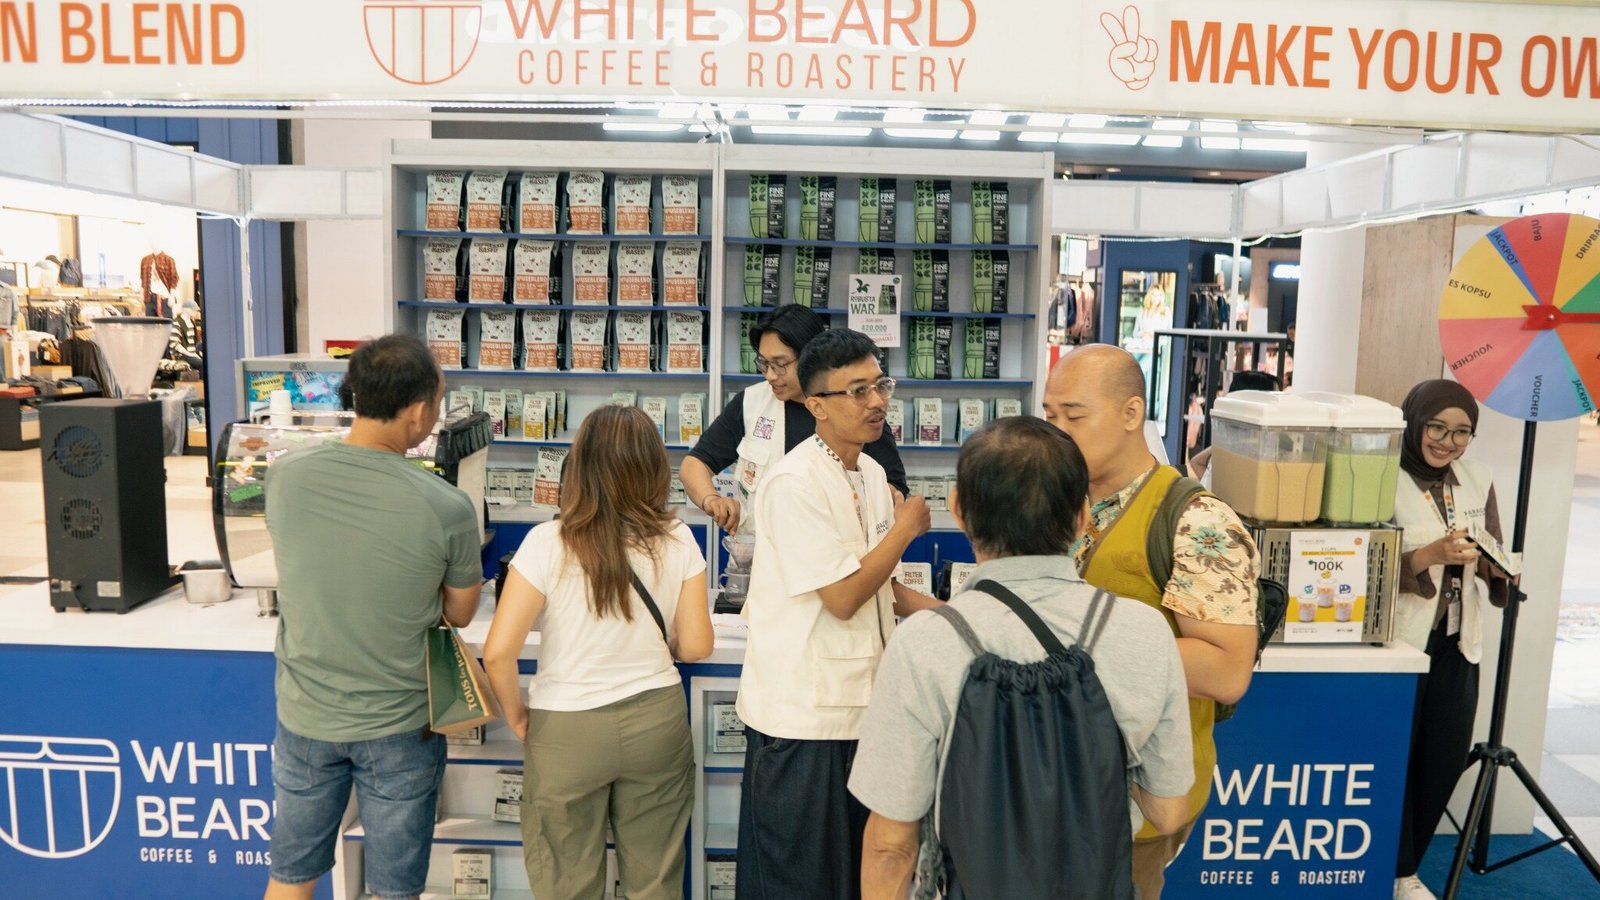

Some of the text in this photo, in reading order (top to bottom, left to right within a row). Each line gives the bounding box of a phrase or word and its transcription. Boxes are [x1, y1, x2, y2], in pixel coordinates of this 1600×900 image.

[61, 2, 246, 65] BLEND
[507, 0, 720, 42] WHITE
[747, 0, 977, 48] BEARD
[518, 49, 966, 93] COFFEE & ROASTERY
[1169, 19, 1600, 99] MAKE YOUR OW
[1490, 232, 1518, 266] JACKPOT
[1448, 279, 1492, 299] ES KOPSU
[850, 304, 875, 314] WAR
[1452, 344, 1493, 370] VOUCHER
[1530, 374, 1542, 418] VOUCHER
[1571, 378, 1592, 412] JACKPOT
[1312, 561, 1343, 570] 100K
[461, 680, 477, 711] TOUS
[130, 739, 274, 786] WHIT
[1213, 764, 1374, 806] WHITE
[136, 796, 277, 841] BEAR
[140, 847, 272, 866] COFFEE & ROAS
[1202, 819, 1372, 860] BEARD
[1200, 870, 1366, 885] COFFEE & ROASTERY
